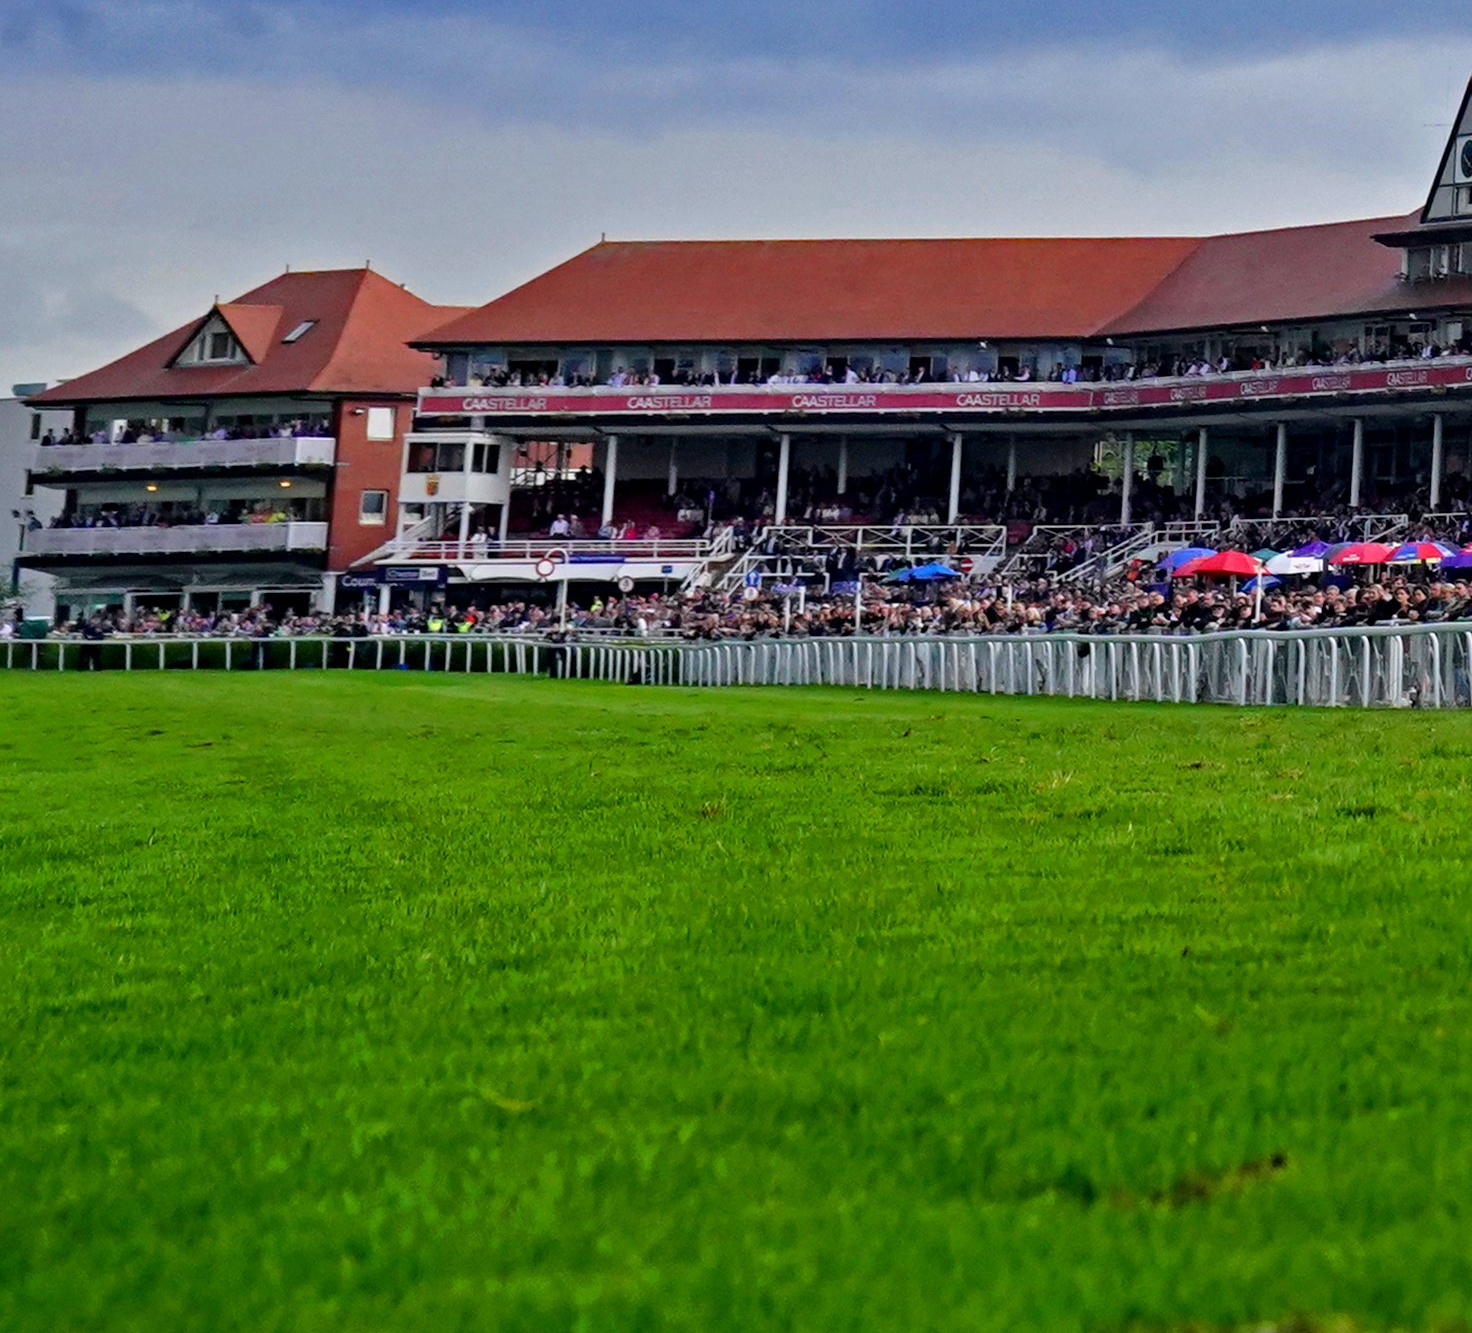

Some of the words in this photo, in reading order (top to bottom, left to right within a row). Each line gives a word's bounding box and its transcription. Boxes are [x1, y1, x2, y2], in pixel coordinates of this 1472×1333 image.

[462, 396, 547, 411] CAASTELLAR
[626, 395, 713, 410] CAASTELLAR
[792, 395, 877, 408] CAASTELLAR
[956, 393, 1041, 407] CAASTELLAR
